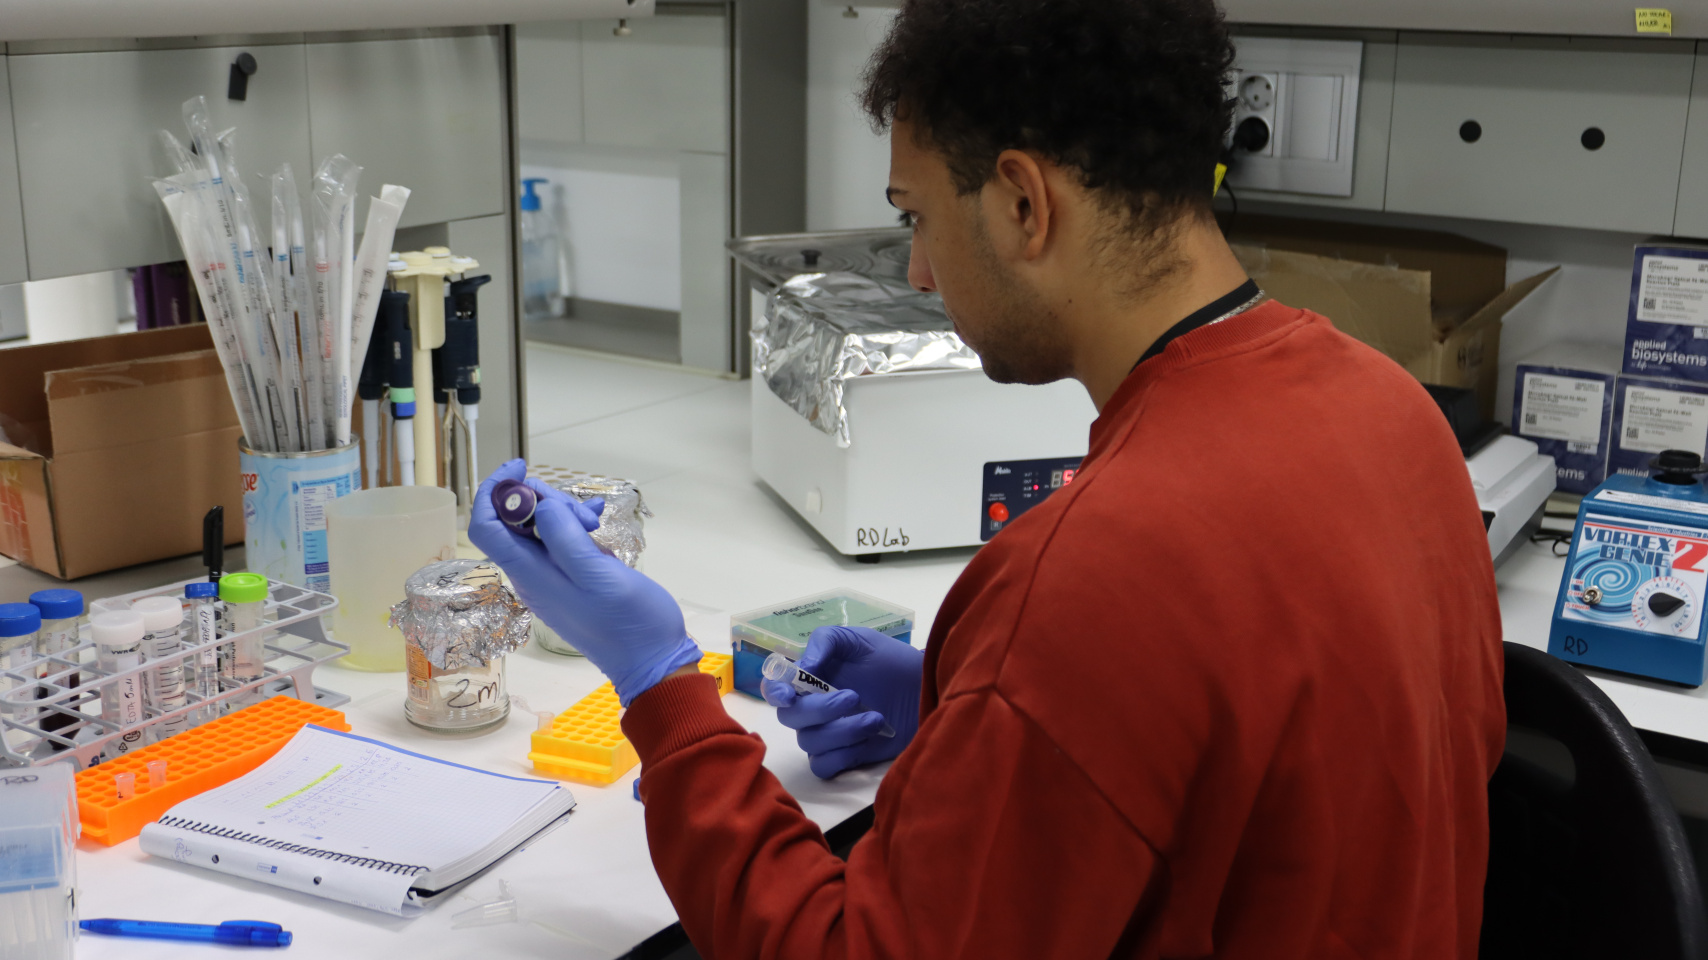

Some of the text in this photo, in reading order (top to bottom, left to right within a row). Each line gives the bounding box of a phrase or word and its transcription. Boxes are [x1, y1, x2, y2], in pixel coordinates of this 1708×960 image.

[1633, 339, 1667, 351] applied
[1631, 347, 1708, 367] biosystems
[857, 527, 910, 547] RD Lab
[1599, 540, 1708, 573] GENIE 2
[1563, 635, 1588, 657] RD
